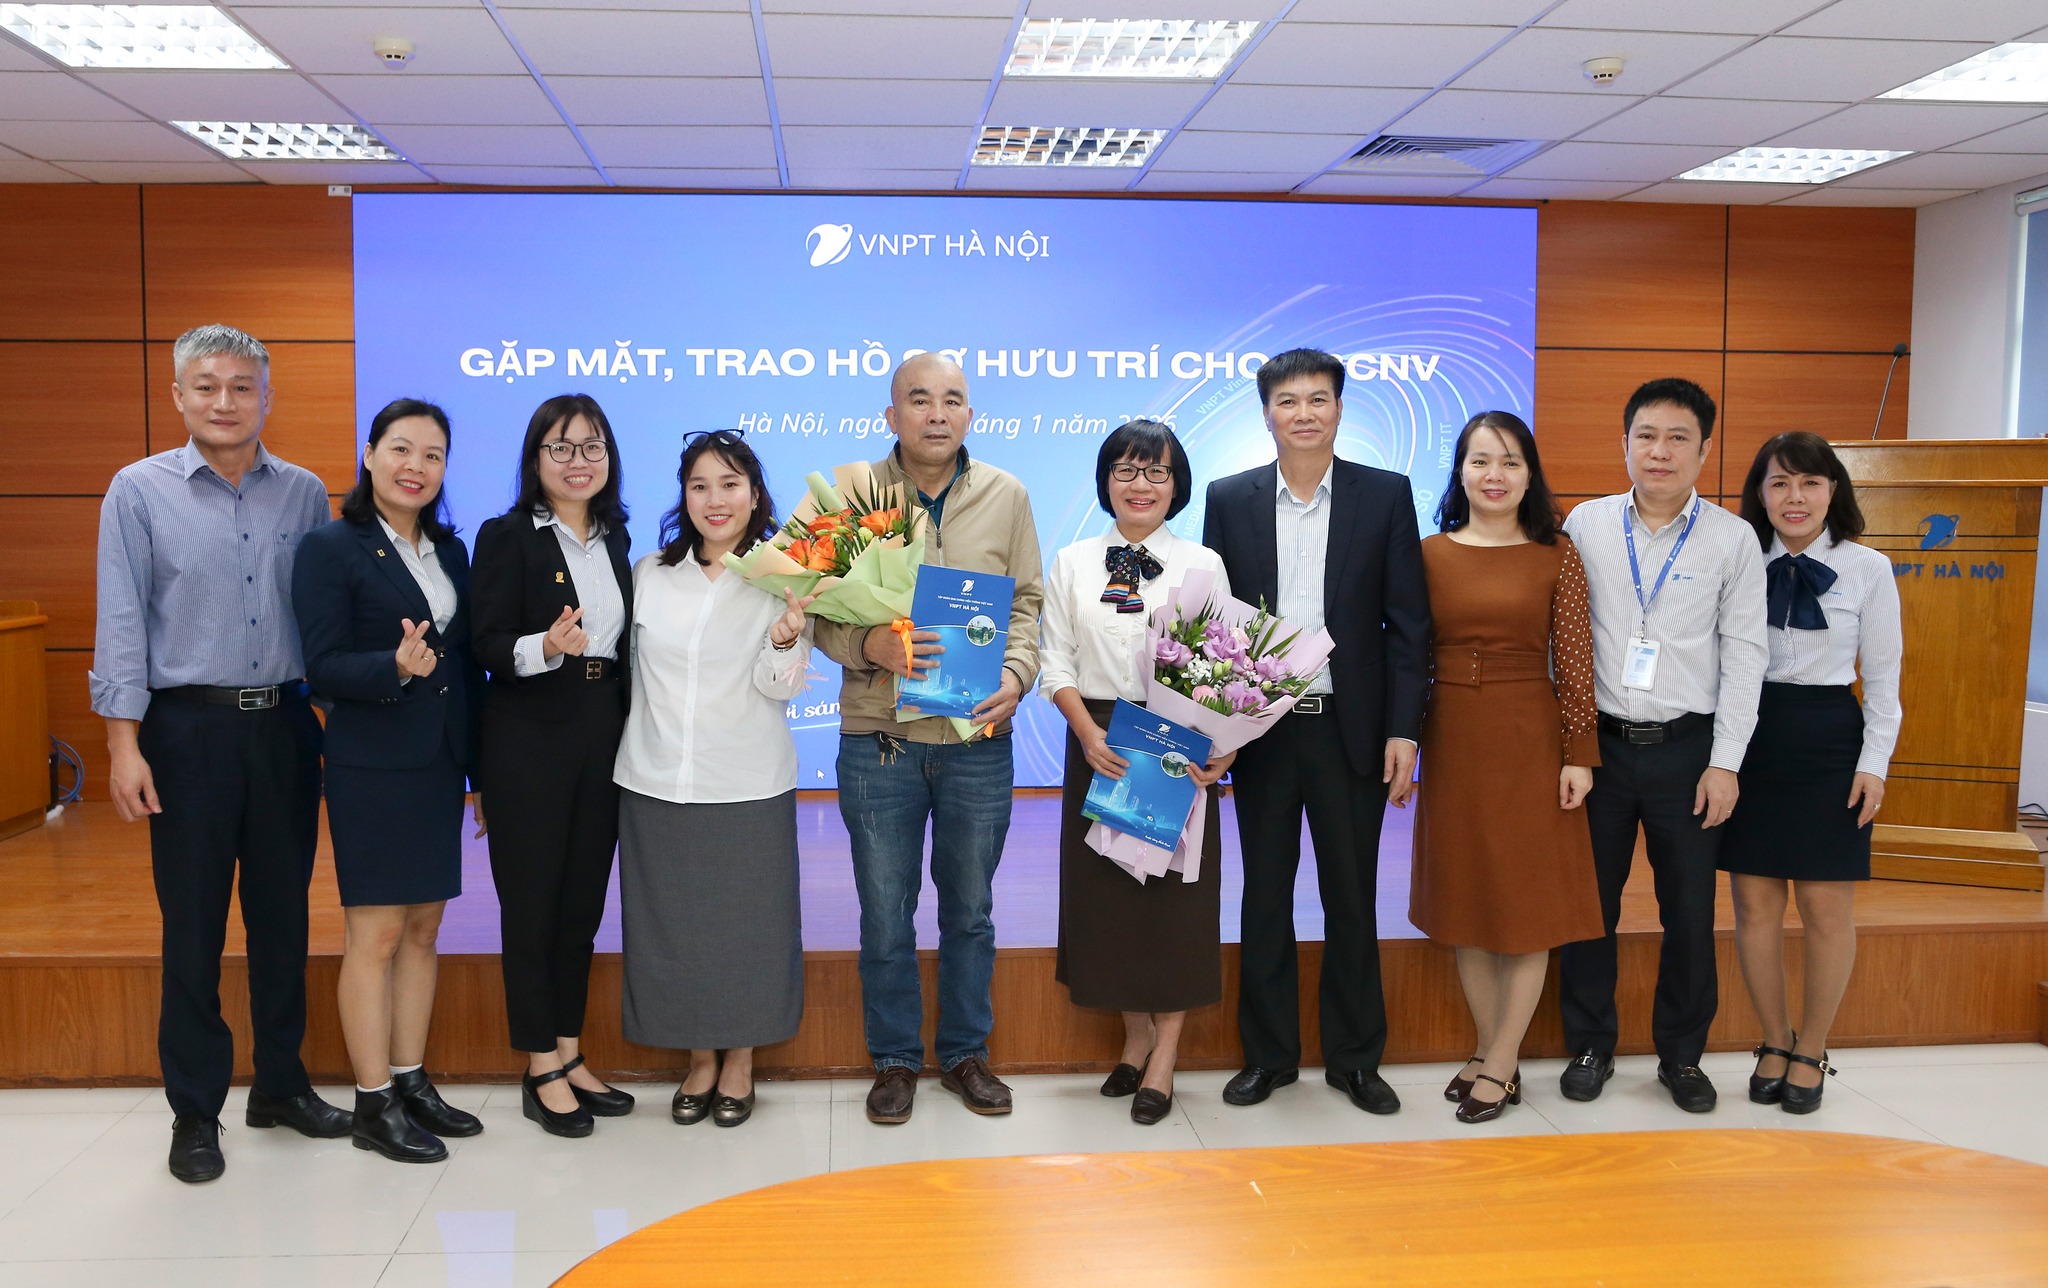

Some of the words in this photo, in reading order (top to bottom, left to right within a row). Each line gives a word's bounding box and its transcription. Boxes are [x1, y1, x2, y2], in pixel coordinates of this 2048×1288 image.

[858, 234, 936, 257] VNPT
[945, 229, 986, 257] HÀ
[995, 229, 1050, 262] NỘI
[460, 339, 556, 384] GẶP
[567, 339, 674, 383] MẶT,
[686, 348, 816, 377] TRAO
[828, 338, 891, 377] HỒ
[977, 347, 1076, 378] HƯU
[1087, 344, 1160, 379] TRÍ
[1171, 350, 1270, 380] CHO
[1330, 353, 1441, 381] CNV
[1196, 390, 1226, 415] VNPT
[738, 411, 773, 434] Hà
[780, 411, 829, 438] Nội,
[969, 412, 1021, 440] áng
[1032, 414, 1042, 434] 1
[1051, 413, 1108, 435] năm
[1440, 422, 1452, 434] IT
[1438, 437, 1452, 469] VNPT
[1892, 563, 1925, 577] NPT
[1934, 561, 1962, 578] HÀ
[1970, 561, 2005, 582] NỘI
[804, 700, 840, 718] sán
